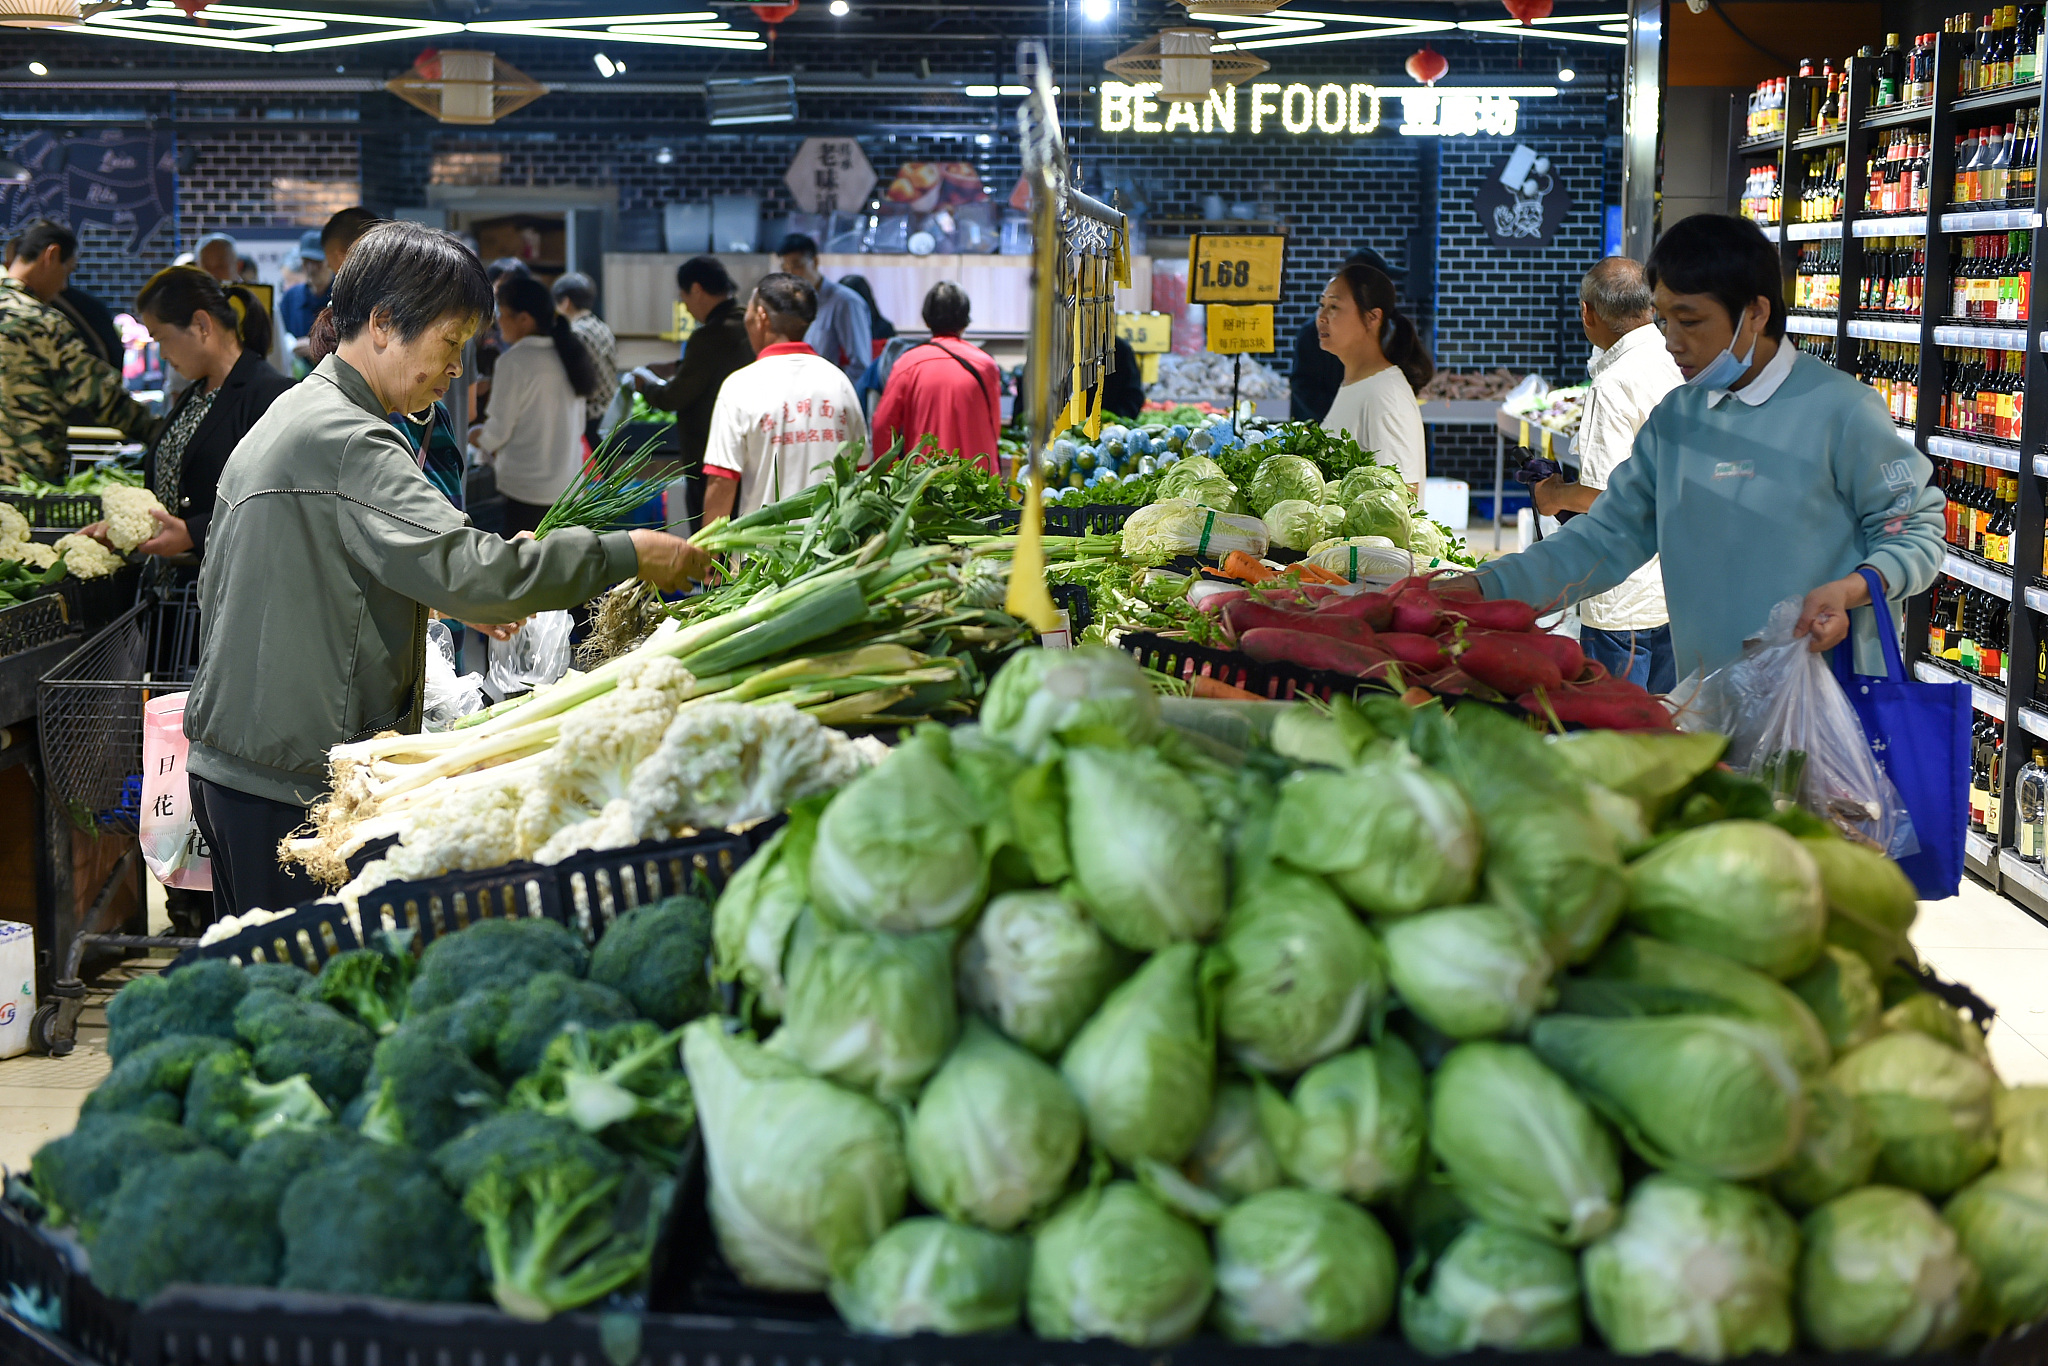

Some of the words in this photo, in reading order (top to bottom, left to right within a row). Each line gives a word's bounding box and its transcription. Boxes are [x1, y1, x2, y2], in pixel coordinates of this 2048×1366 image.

[1101, 82, 1236, 133] BEAN
[1251, 82, 1381, 135] FOOD
[1199, 260, 1251, 288] 1.68
